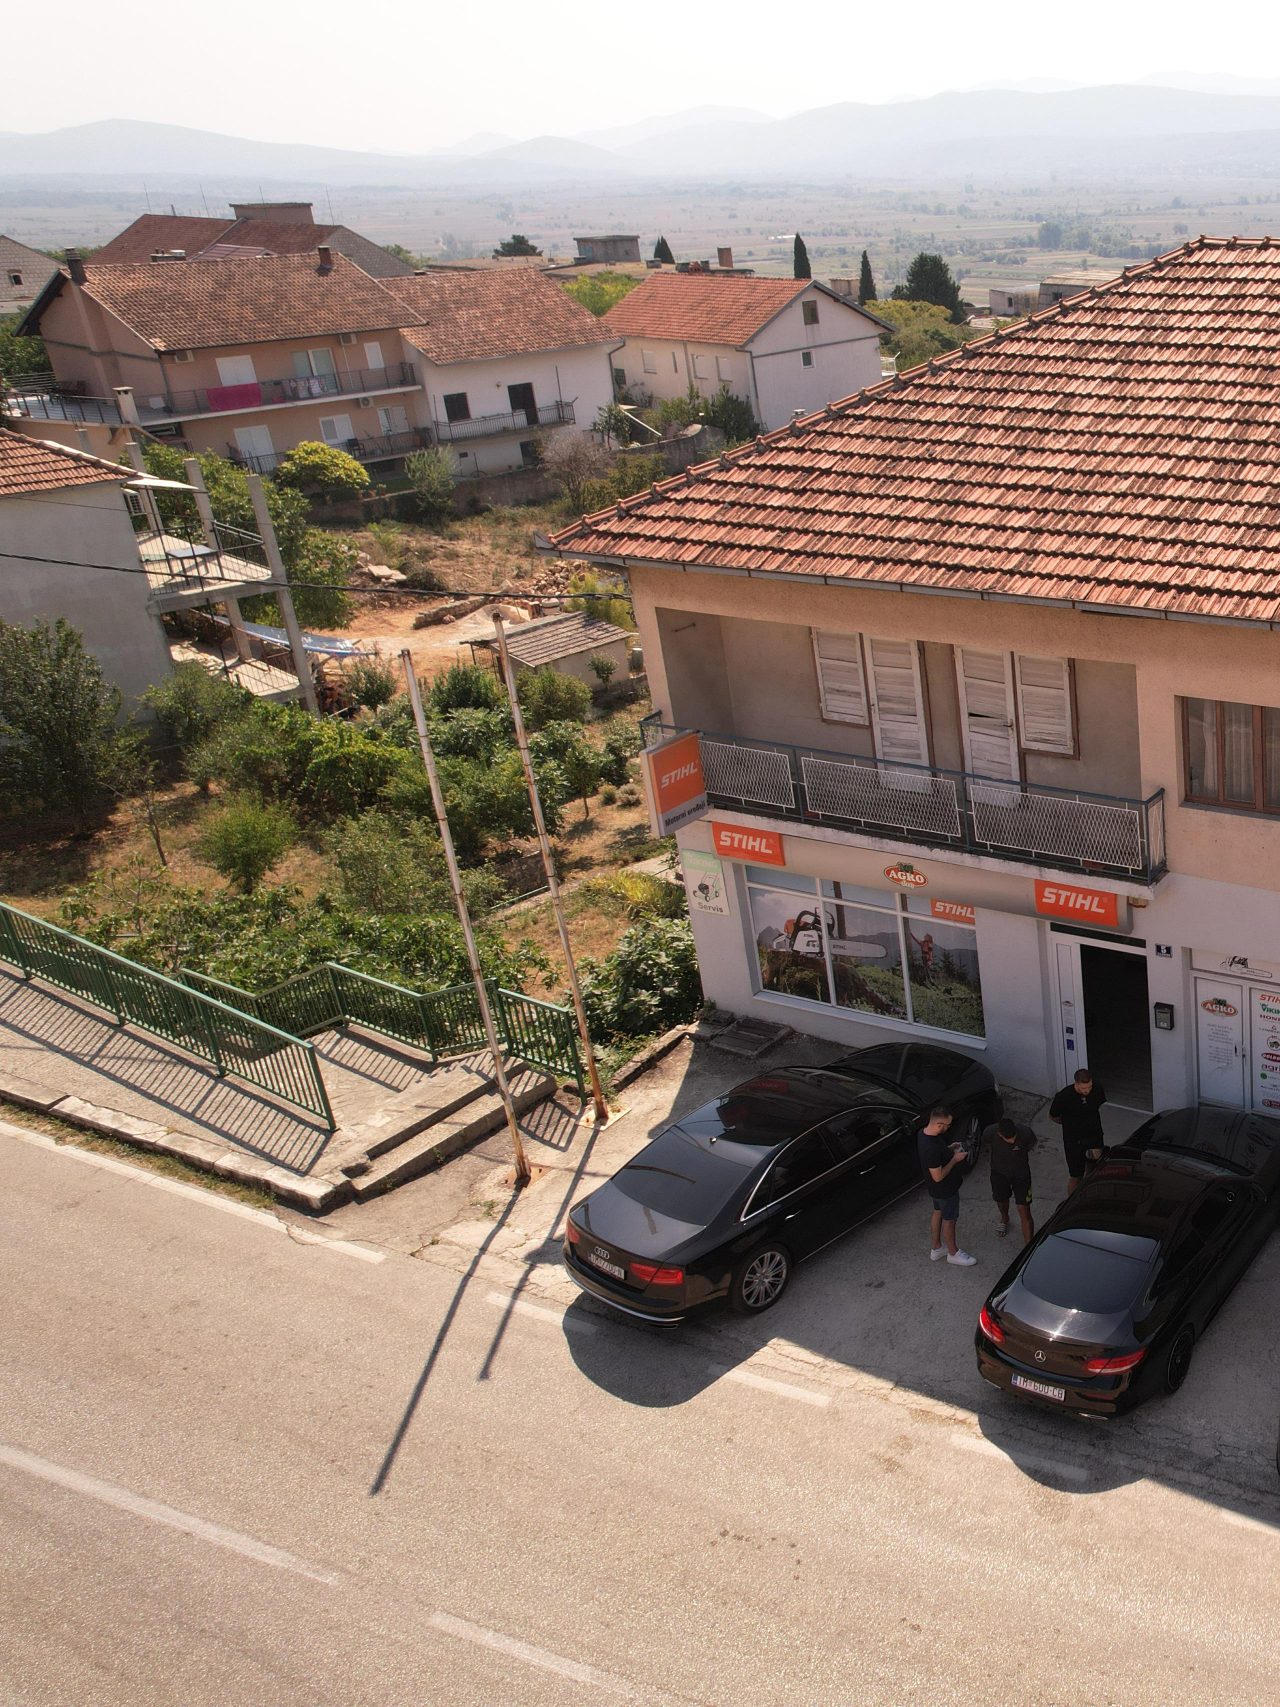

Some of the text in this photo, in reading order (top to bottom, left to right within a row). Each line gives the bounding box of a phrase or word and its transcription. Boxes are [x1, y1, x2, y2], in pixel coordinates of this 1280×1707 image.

[661, 762, 698, 789] STIHL
[664, 811, 687, 827] Motorni
[720, 831, 773, 854] STIHL
[889, 870, 925, 884] AGRO
[698, 902, 724, 913] Servis
[1042, 887, 1105, 914] STIHL
[935, 901, 976, 918] STIHL
